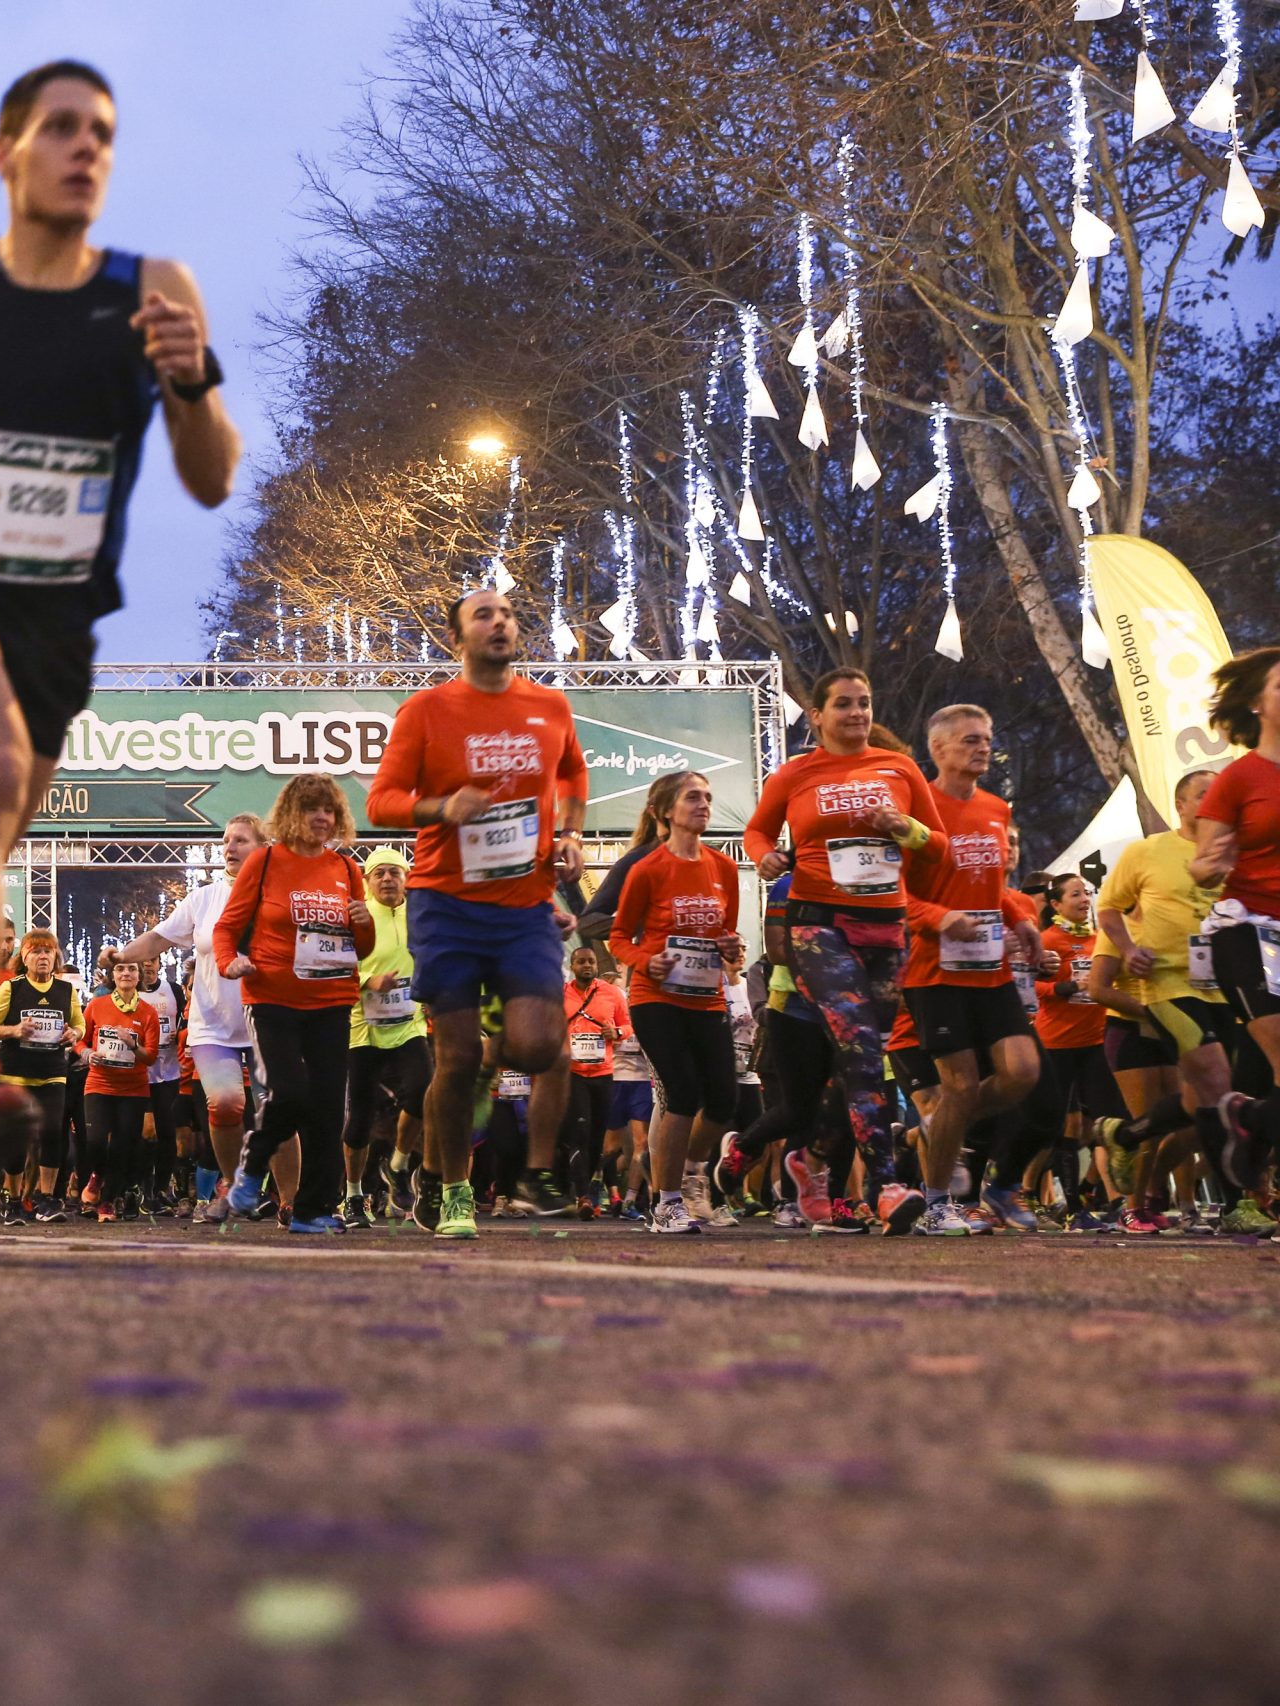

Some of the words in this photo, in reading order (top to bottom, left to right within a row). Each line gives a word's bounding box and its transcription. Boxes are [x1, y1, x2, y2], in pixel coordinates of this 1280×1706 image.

[63, 720, 256, 761] ilvestre
[268, 721, 389, 764] LISB
[470, 755, 541, 773] LISBOA
[583, 749, 626, 768] Corte
[626, 745, 689, 775] Inglés
[36, 785, 89, 817] IÇÃO
[821, 795, 895, 813] LISBOA
[955, 852, 1001, 867] LISBOA
[294, 908, 345, 923] LISBOA
[319, 940, 336, 952] 264
[108, 1041, 124, 1052] 3711
